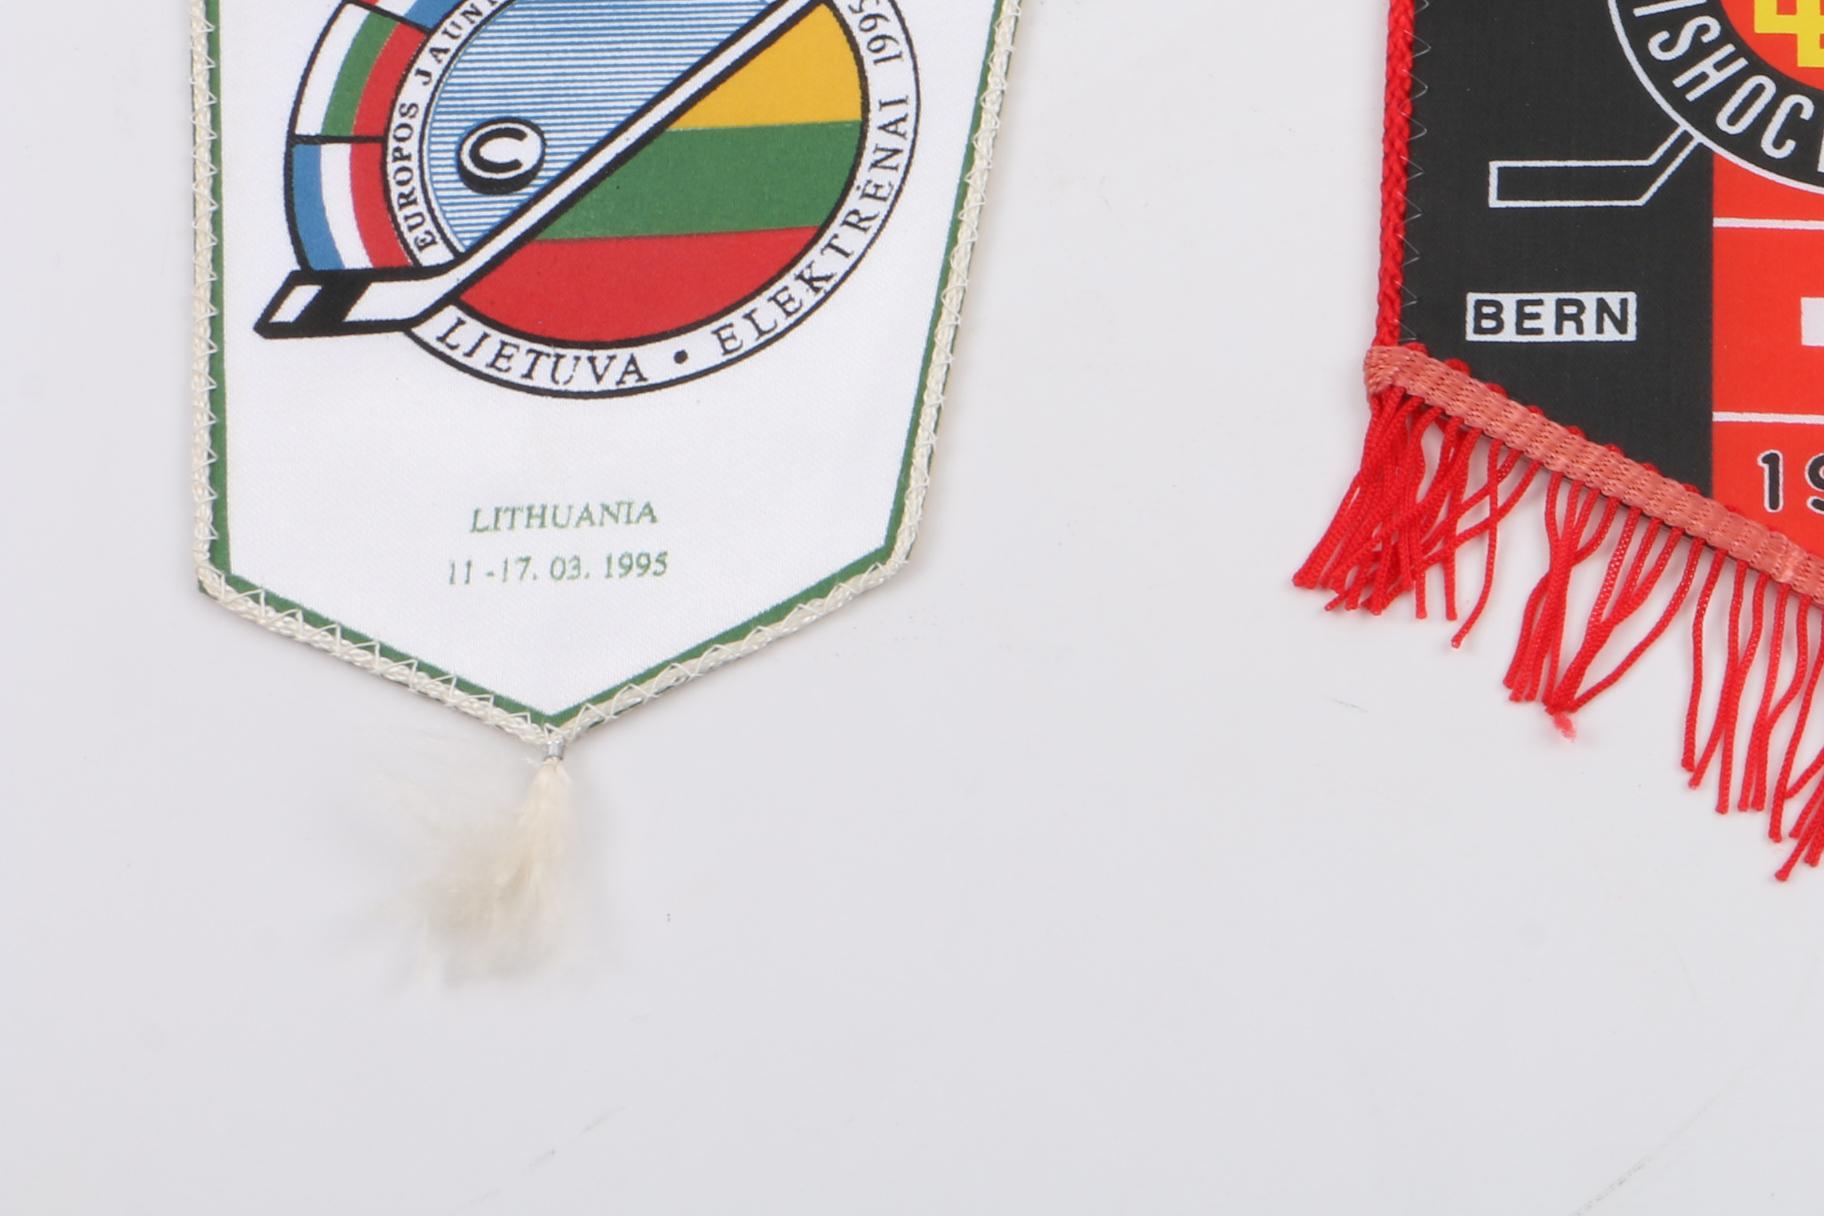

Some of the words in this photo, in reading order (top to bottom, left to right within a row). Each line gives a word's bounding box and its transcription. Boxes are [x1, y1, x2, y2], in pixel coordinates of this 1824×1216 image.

[391, 101, 438, 252] EUROPOS
[436, 317, 648, 385] LIETUVA
[711, 95, 909, 355] ELEKTRĖNAI
[1473, 297, 1630, 336] BERN
[470, 501, 659, 533] LITHUANIA
[604, 551, 668, 579] 1995
